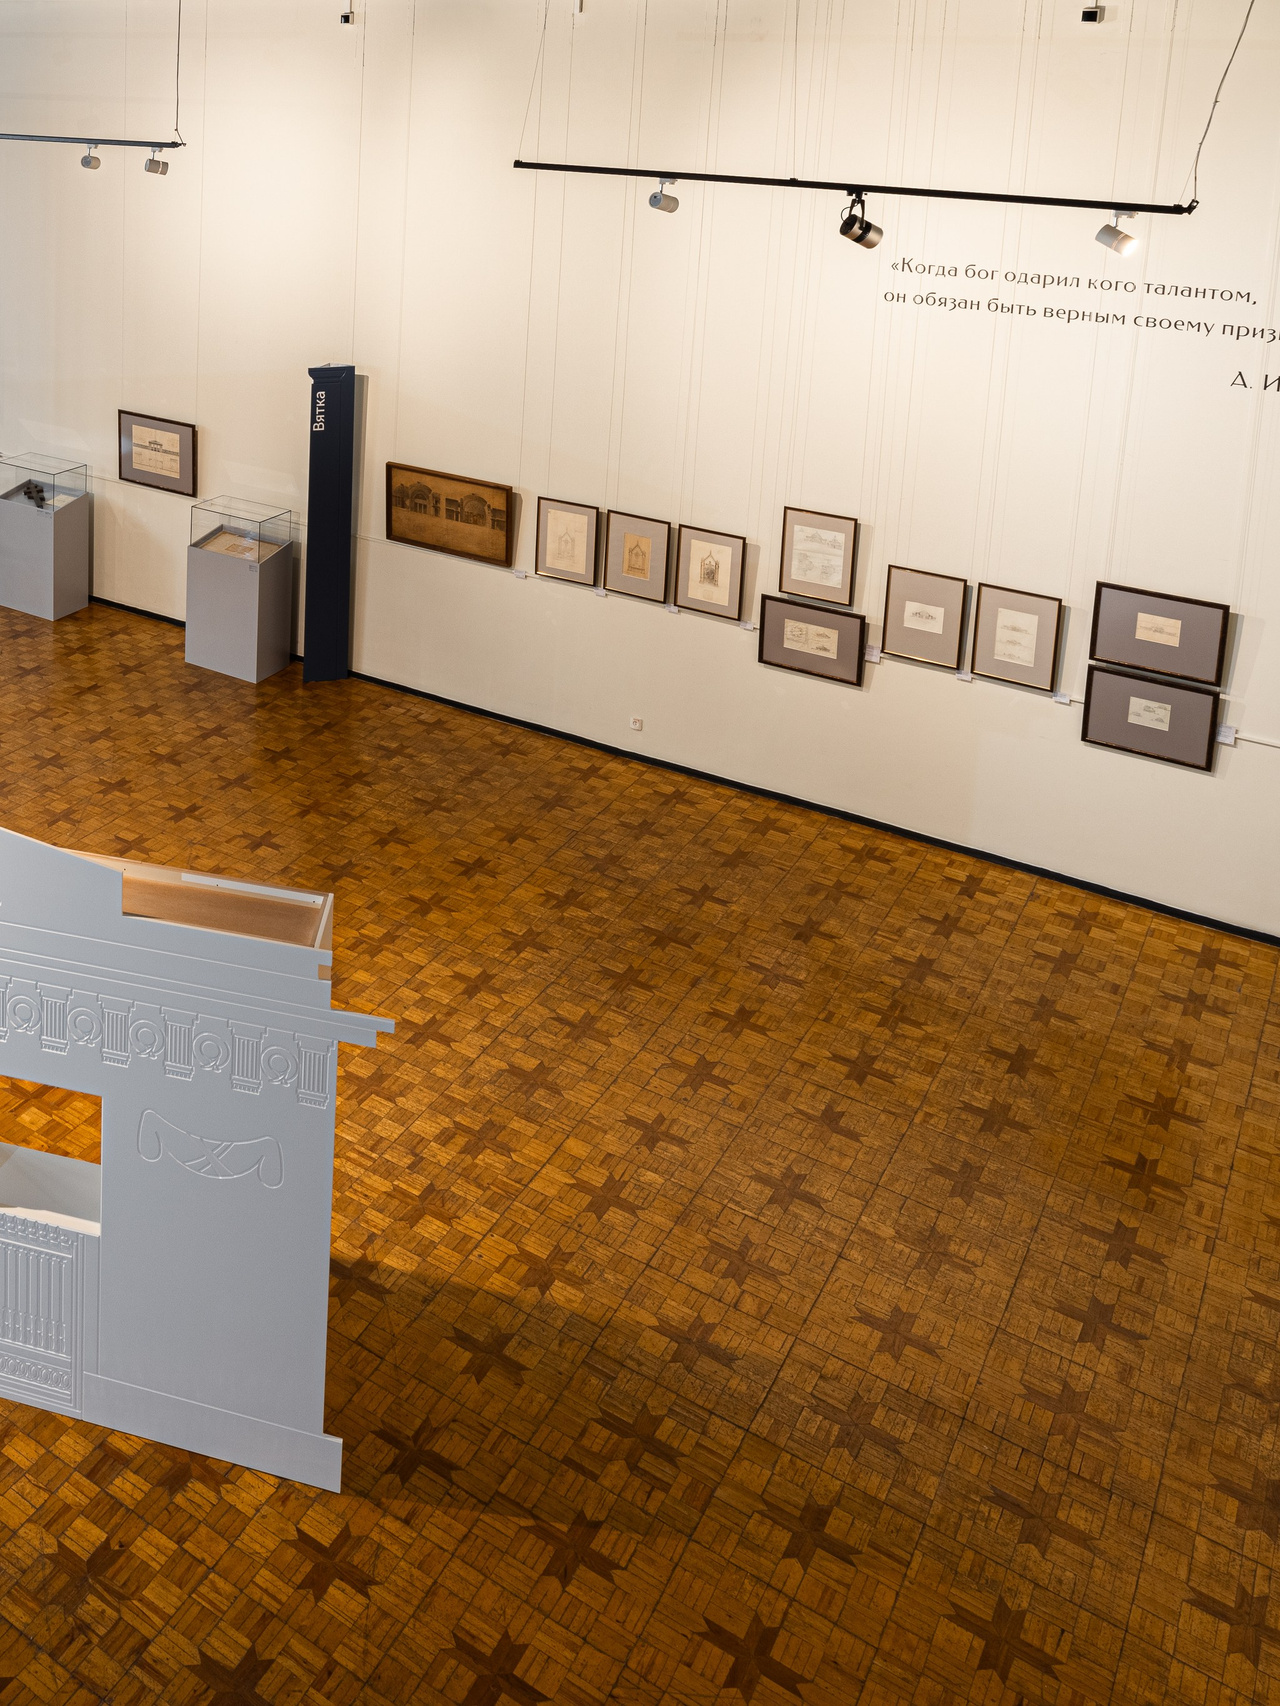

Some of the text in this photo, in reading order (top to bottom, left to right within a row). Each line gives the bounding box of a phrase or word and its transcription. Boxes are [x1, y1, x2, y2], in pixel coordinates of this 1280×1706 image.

[891, 257, 1257, 305] «Когда бог одарил кого талантом,
[883, 291, 1280, 343] он обязан быть верным своему приз
[1230, 370, 1253, 389] А.
[312, 390, 326, 431] Вятка
